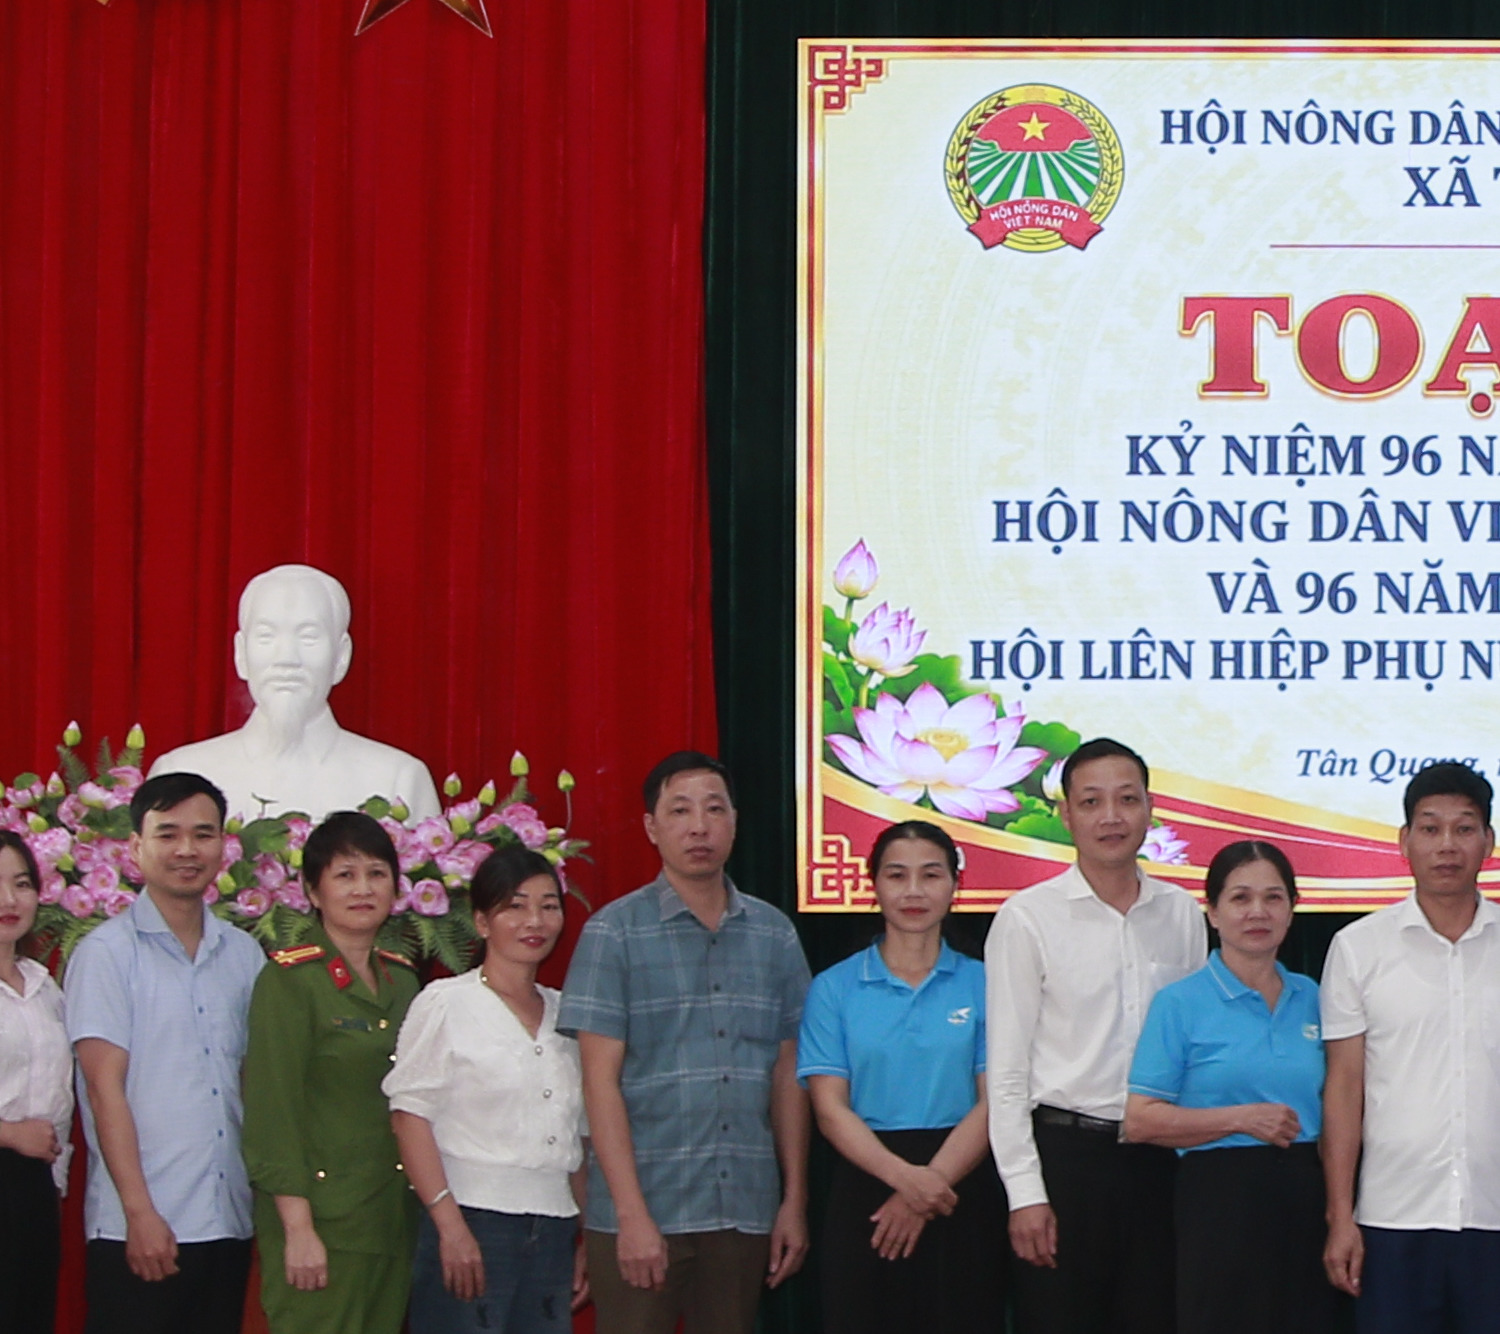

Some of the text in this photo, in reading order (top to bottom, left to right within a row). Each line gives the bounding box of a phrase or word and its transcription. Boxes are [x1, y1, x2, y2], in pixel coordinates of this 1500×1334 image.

[1160, 98, 1247, 155] HỘI
[1261, 98, 1396, 146] NÔNG
[1403, 155, 1482, 208] XÃ
[1126, 421, 1206, 476] KỶ
[1221, 421, 1366, 488] NIỆM
[1380, 434, 1442, 477] 96
[992, 488, 1099, 555] HỘI
[1119, 488, 1290, 543] NÔNG
[1308, 488, 1432, 543] DÂN
[1206, 558, 1283, 614] VÀ
[1295, 571, 1358, 615] 96
[971, 627, 1064, 692] HỘI
[1080, 627, 1195, 680] LIÊN
[1210, 627, 1330, 692] HIỆP
[1342, 640, 1446, 692] PHỤ
[1297, 749, 1358, 778] Tân
